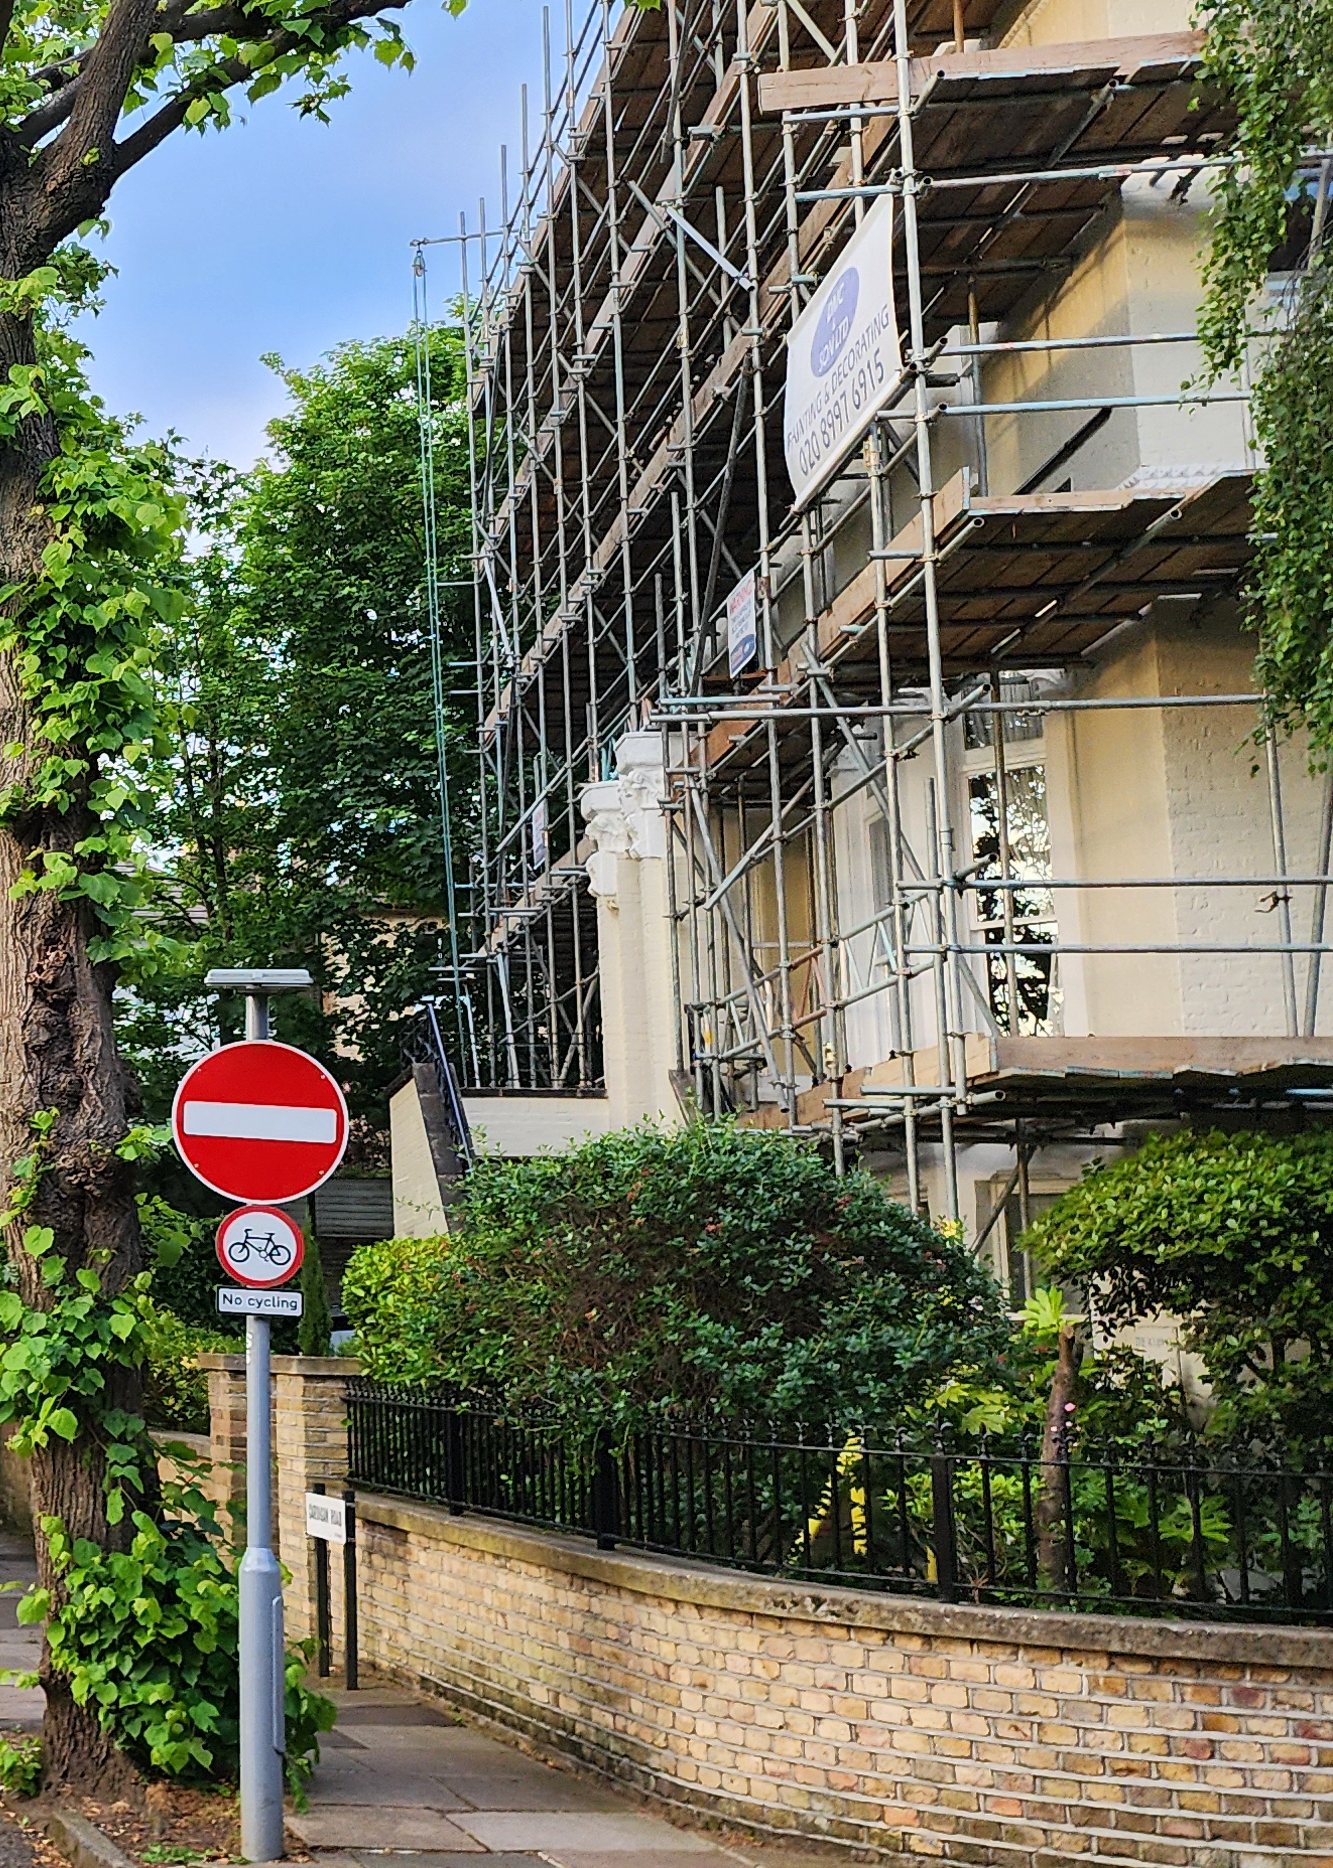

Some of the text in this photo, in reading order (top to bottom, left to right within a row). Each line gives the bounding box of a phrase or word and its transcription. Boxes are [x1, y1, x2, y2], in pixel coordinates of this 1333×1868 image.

[787, 303, 889, 453] PAINTING & DECORATING
[799, 347, 884, 477] 020 8997 6915
[222, 1293, 298, 1311] No cycling
